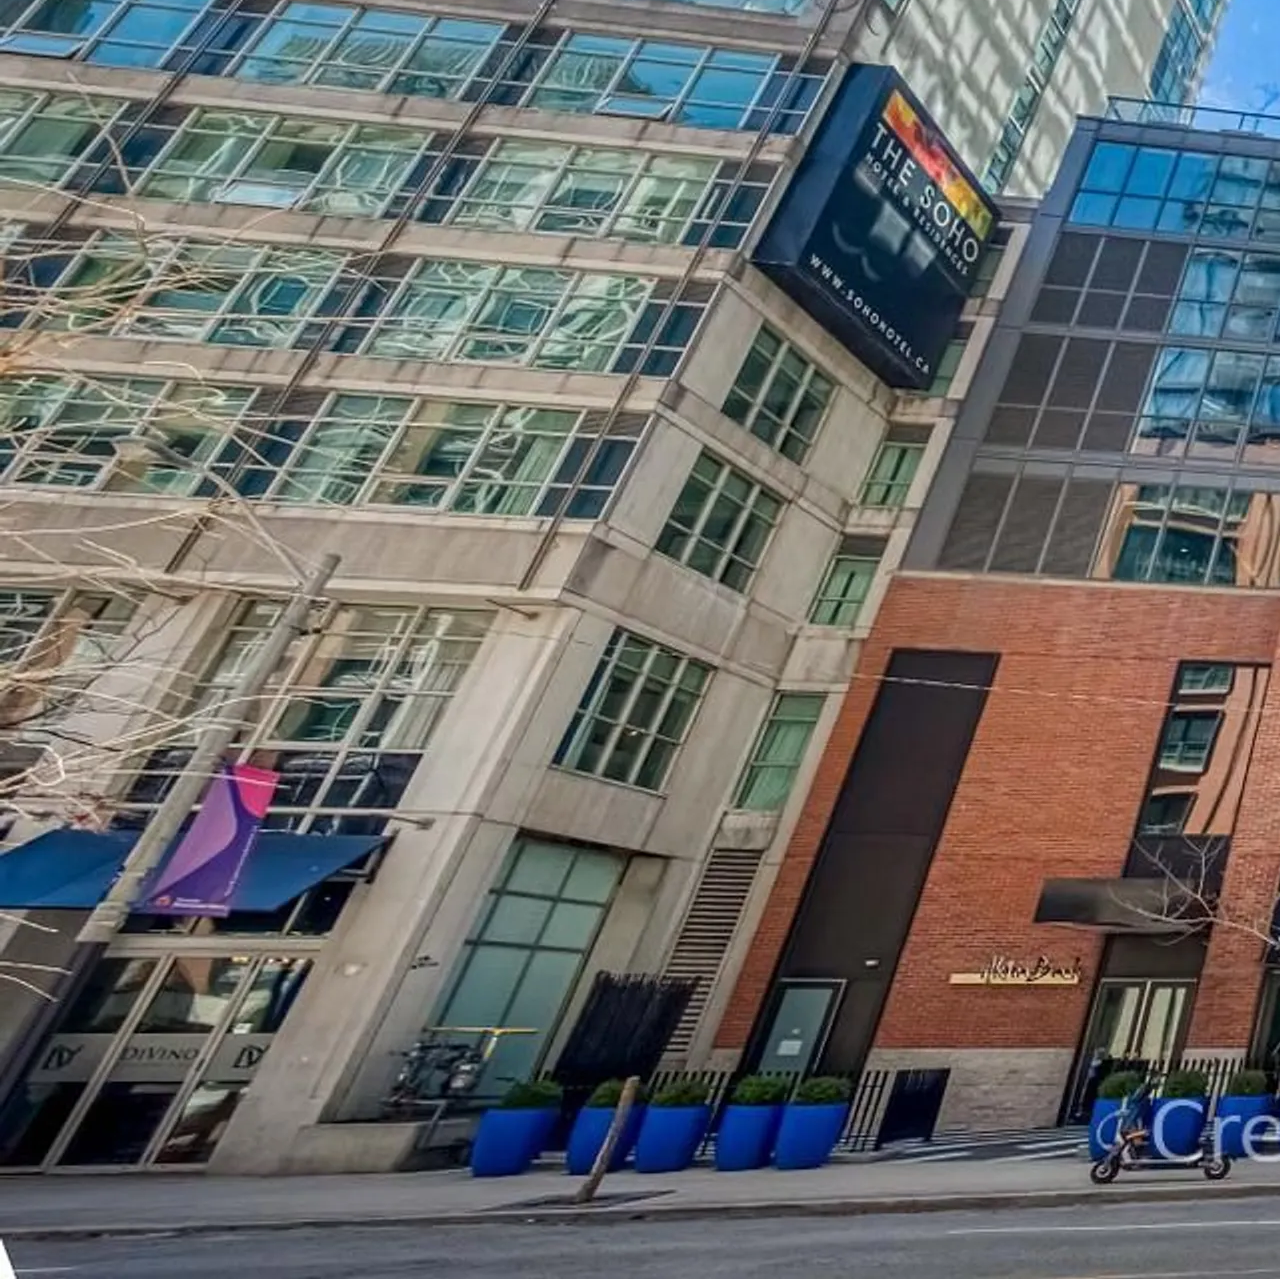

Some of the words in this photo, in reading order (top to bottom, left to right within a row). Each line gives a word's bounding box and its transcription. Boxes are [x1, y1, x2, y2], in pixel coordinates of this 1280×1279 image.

[864, 152, 900, 196] HOTEL
[871, 122, 916, 186] THE
[919, 184, 979, 262] SOHO
[810, 253, 930, 374] WWW.SOHOHOTEL.CA
